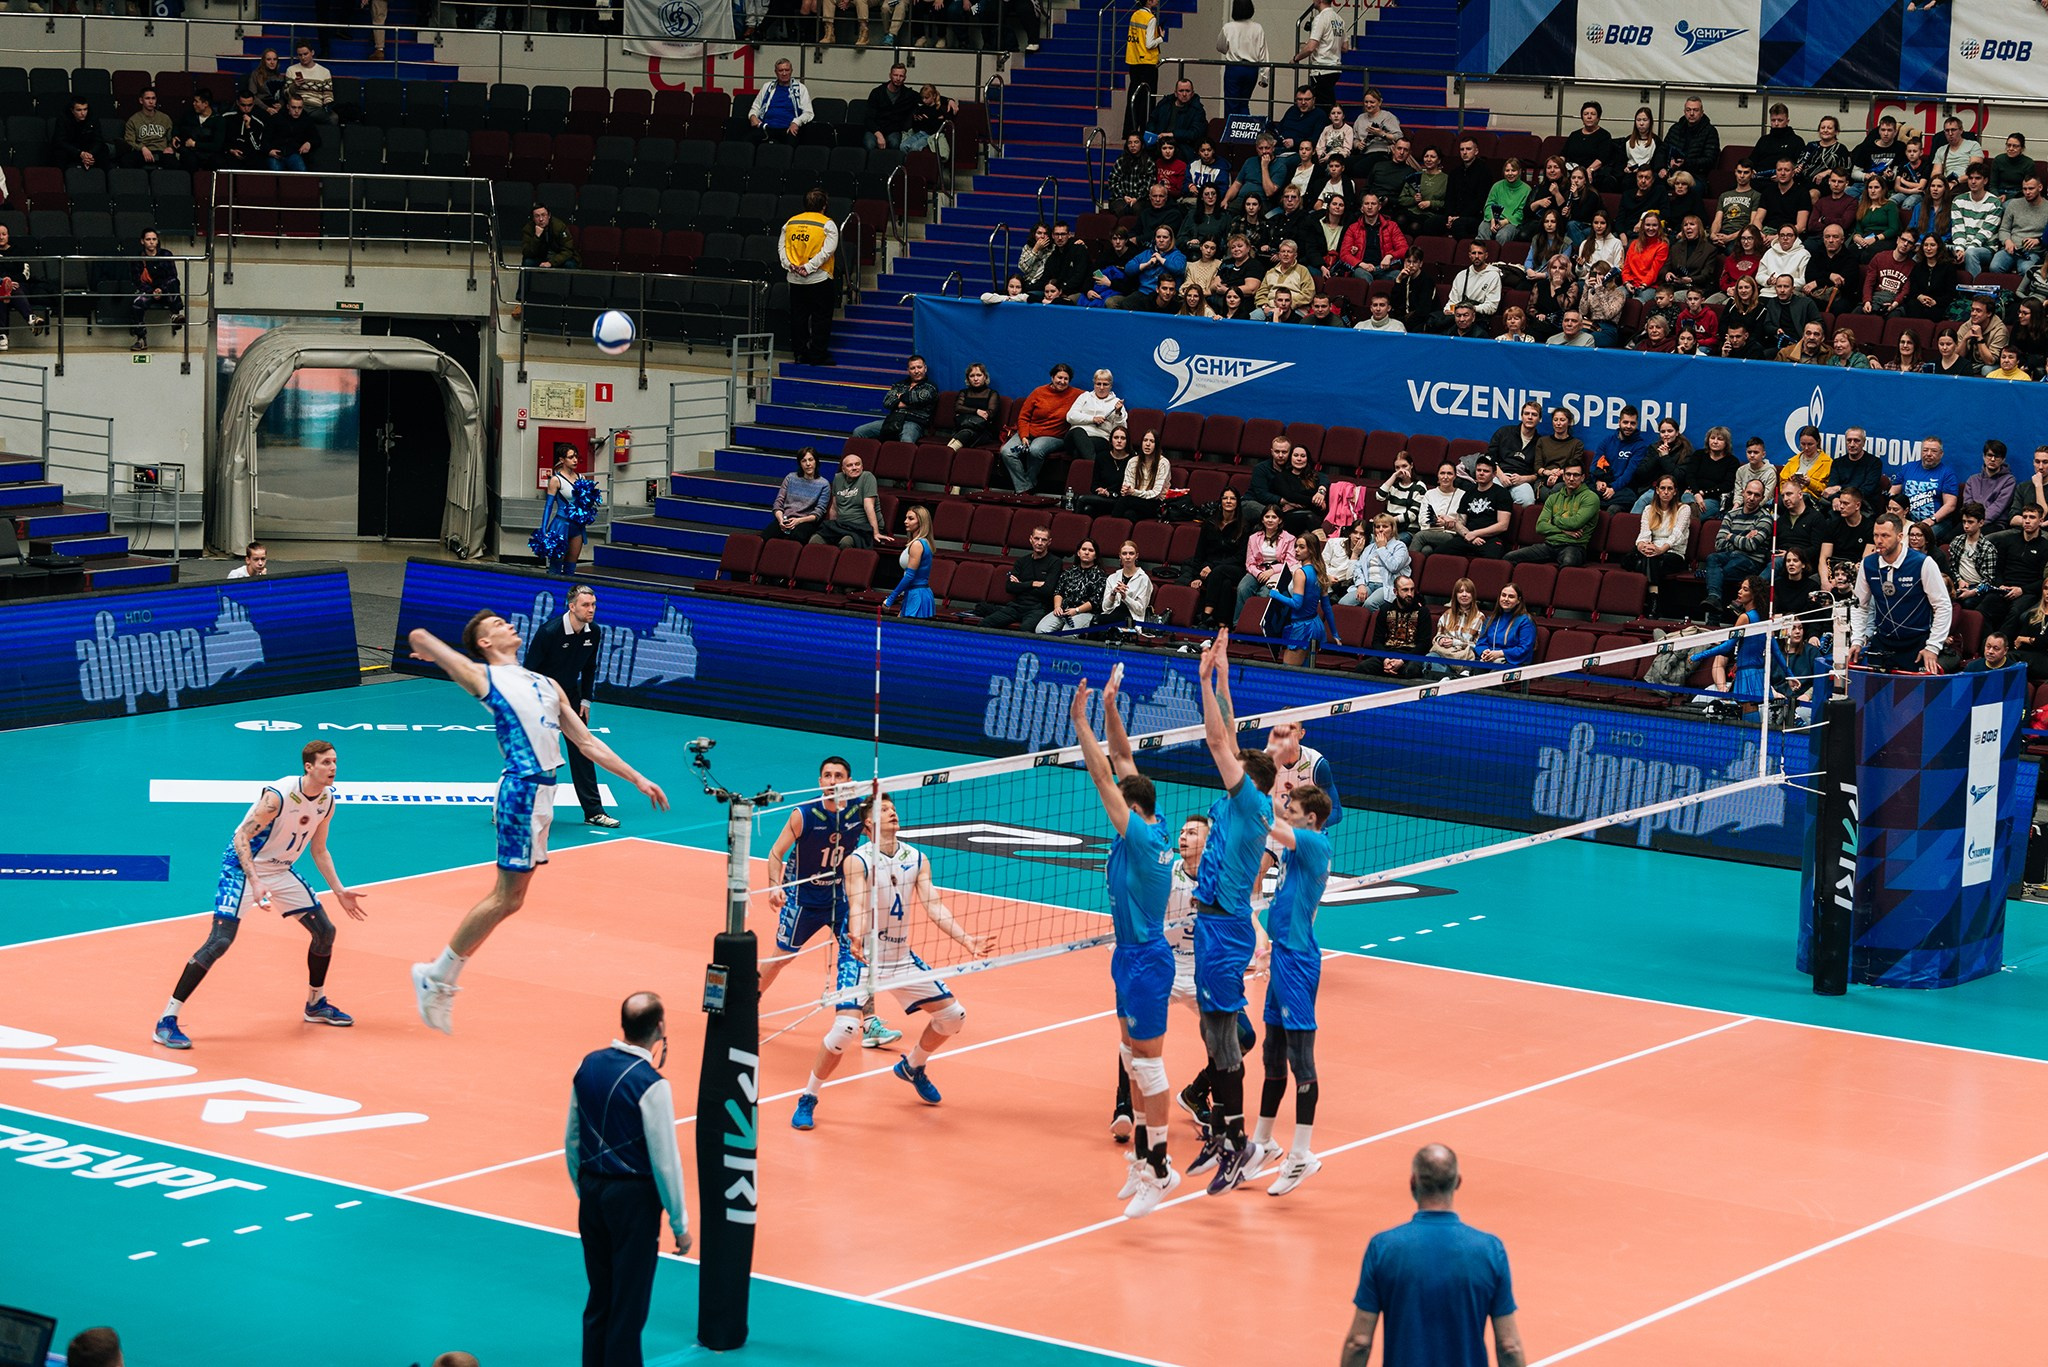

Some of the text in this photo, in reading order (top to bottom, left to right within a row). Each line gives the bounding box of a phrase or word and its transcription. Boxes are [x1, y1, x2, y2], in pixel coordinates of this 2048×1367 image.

[1604, 24, 1654, 46] ВФВ
[1980, 39, 2033, 61] ВФВ
[138, 124, 165, 138] GAP
[1230, 130, 1258, 140] ЗЕНИТ!
[889, 893, 904, 921] 4
